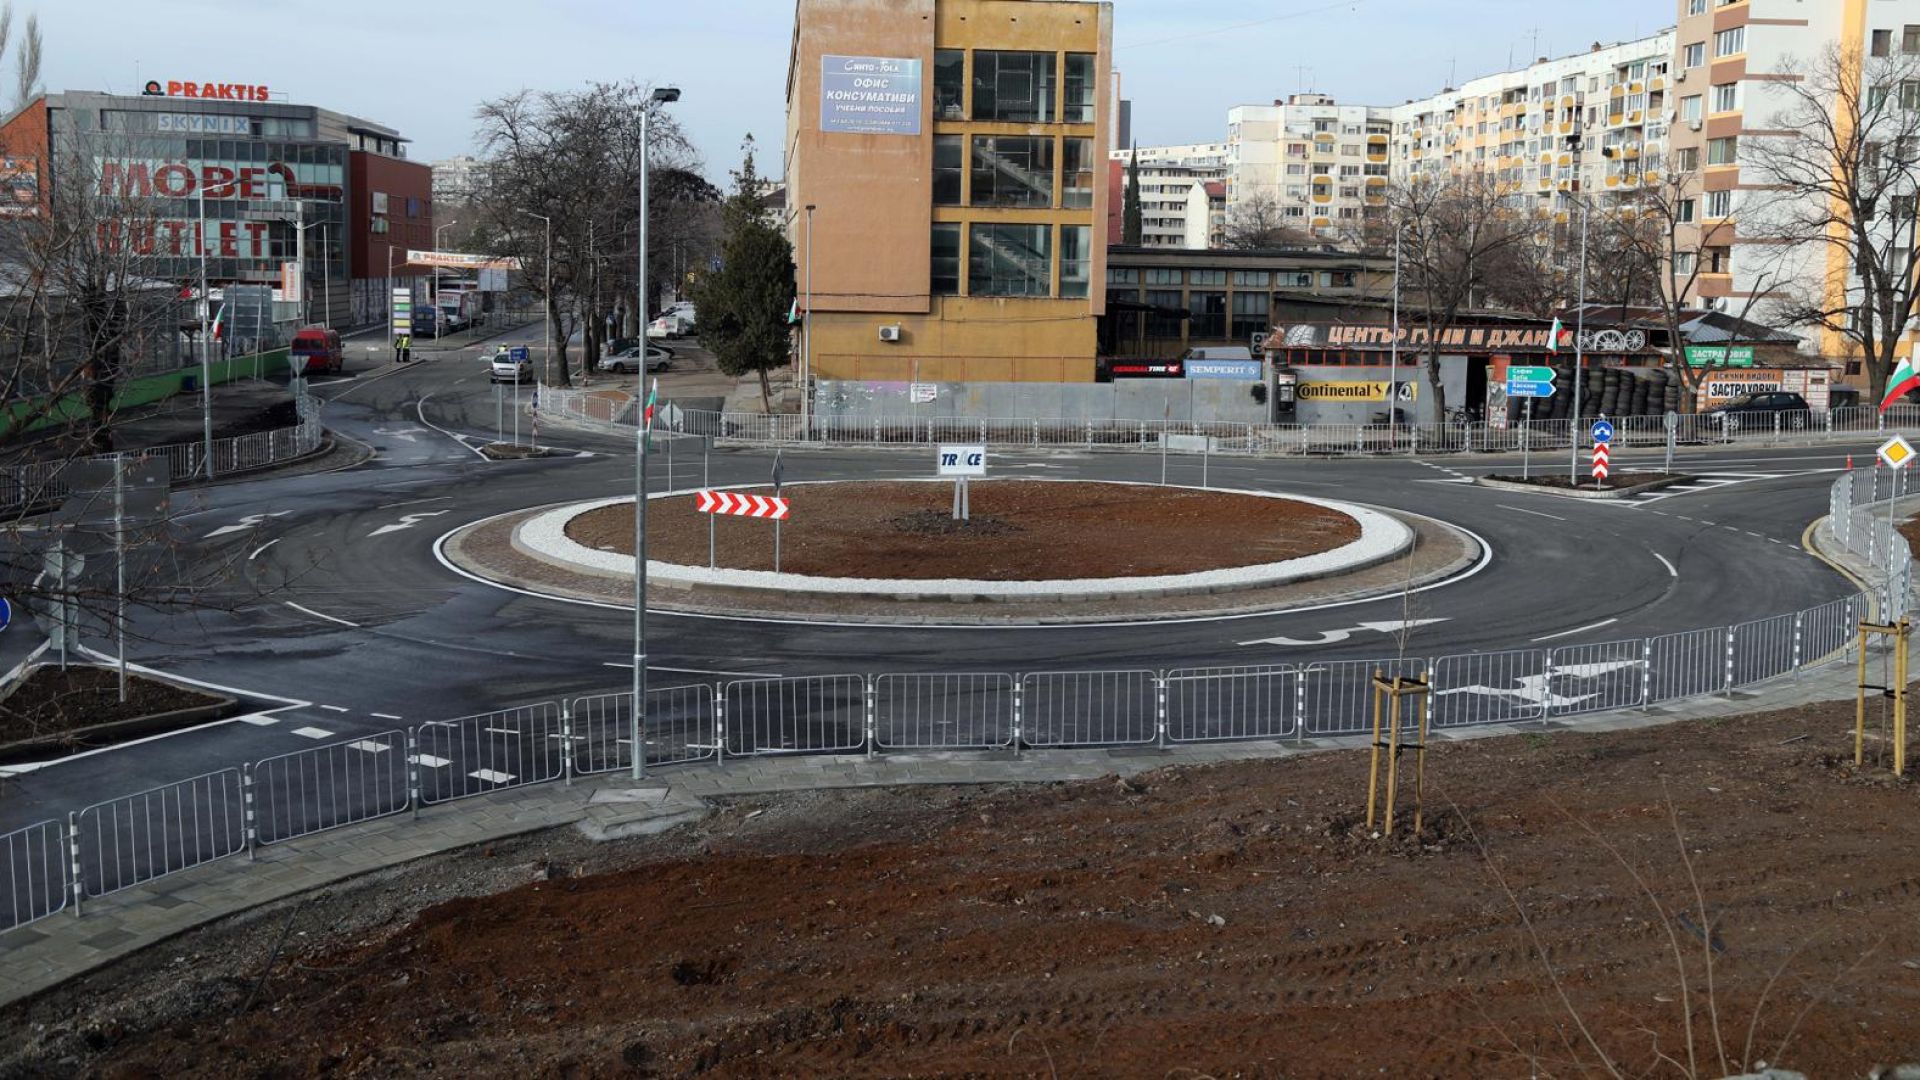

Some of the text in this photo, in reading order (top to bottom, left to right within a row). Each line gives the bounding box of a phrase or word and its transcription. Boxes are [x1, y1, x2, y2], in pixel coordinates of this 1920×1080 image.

[167, 80, 269, 101] PRAKTIS
[854, 78, 889, 88] ОФИС
[827, 90, 915, 103] КОНСУМАТИВИ
[160, 115, 248, 131] SKYNIX
[1328, 326, 1407, 345] ЦЕНТЪР
[1469, 329, 1485, 345] И
[1487, 329, 1574, 348] ДЖАНИ
[1190, 365, 1245, 374] SEMPERIT
[1297, 383, 1371, 400] Continental
